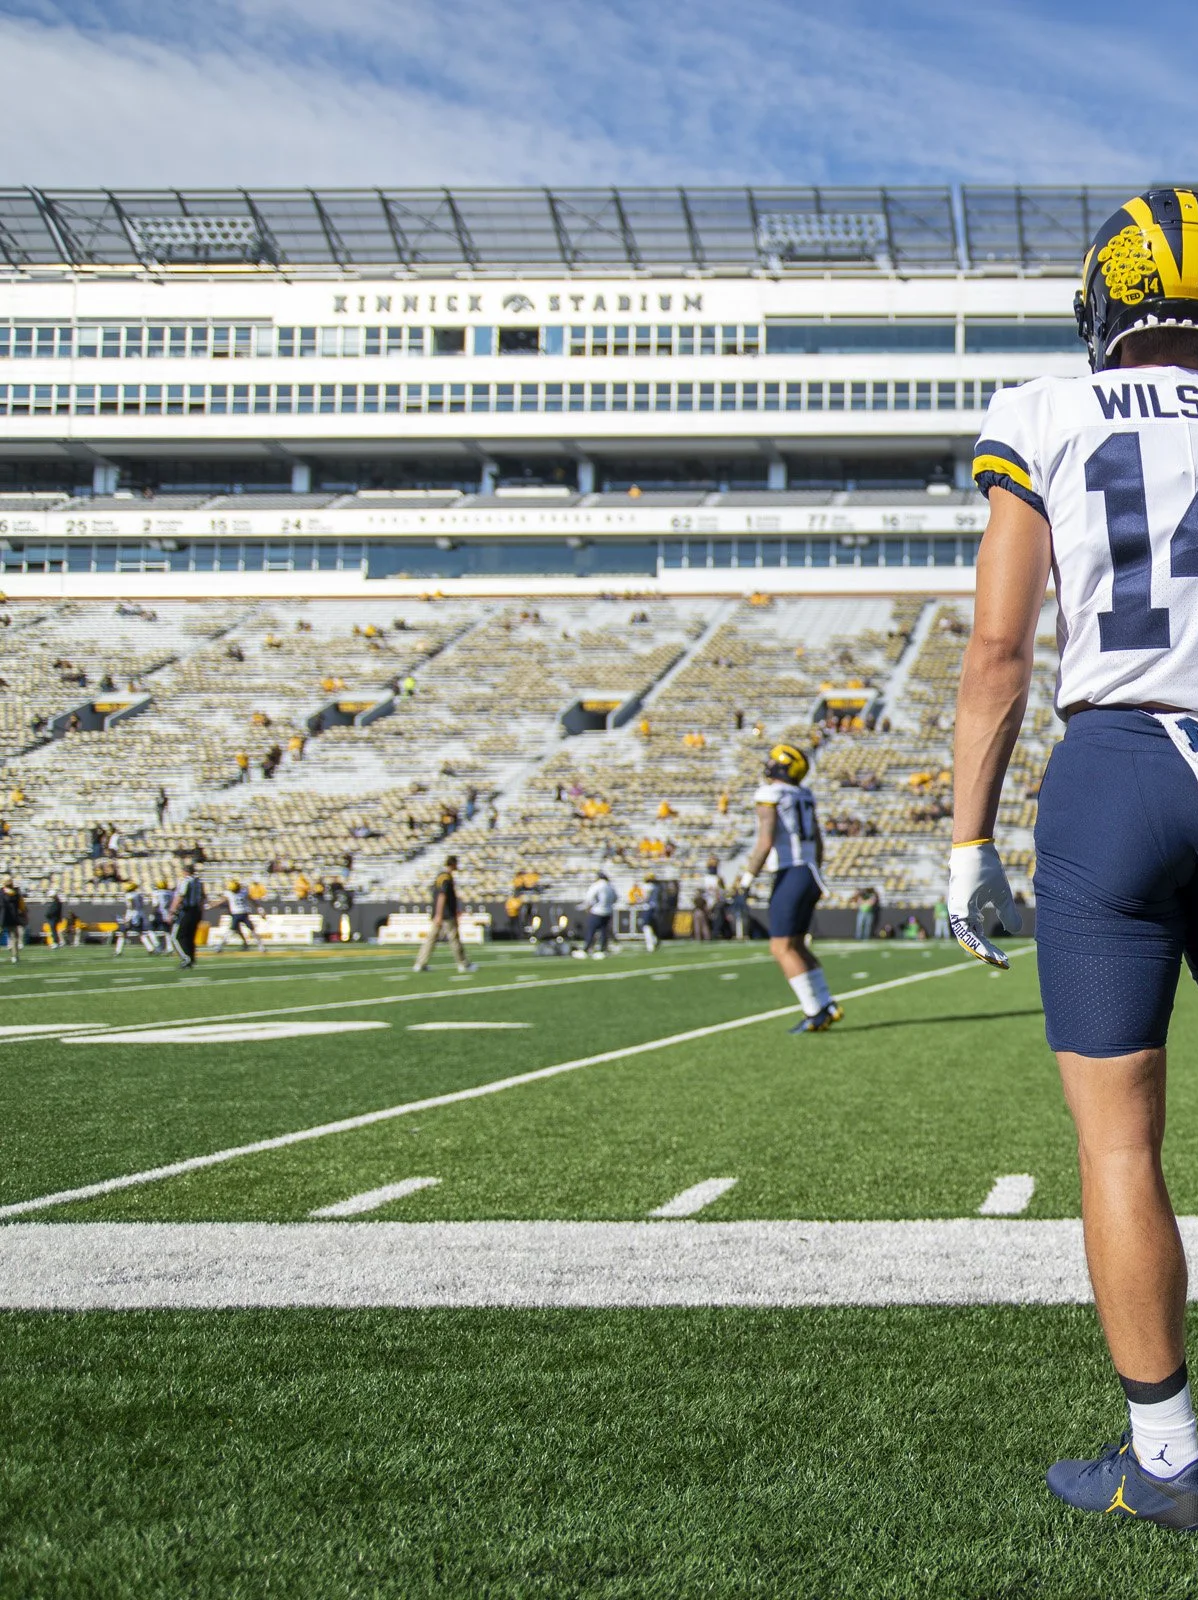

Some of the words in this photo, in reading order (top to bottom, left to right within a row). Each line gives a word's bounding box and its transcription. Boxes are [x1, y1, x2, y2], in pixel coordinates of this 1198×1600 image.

[1144, 277, 1159, 293] 14
[333, 295, 482, 313] KINNICK
[549, 294, 703, 313] STADIUM
[1125, 293, 1141, 302] TED
